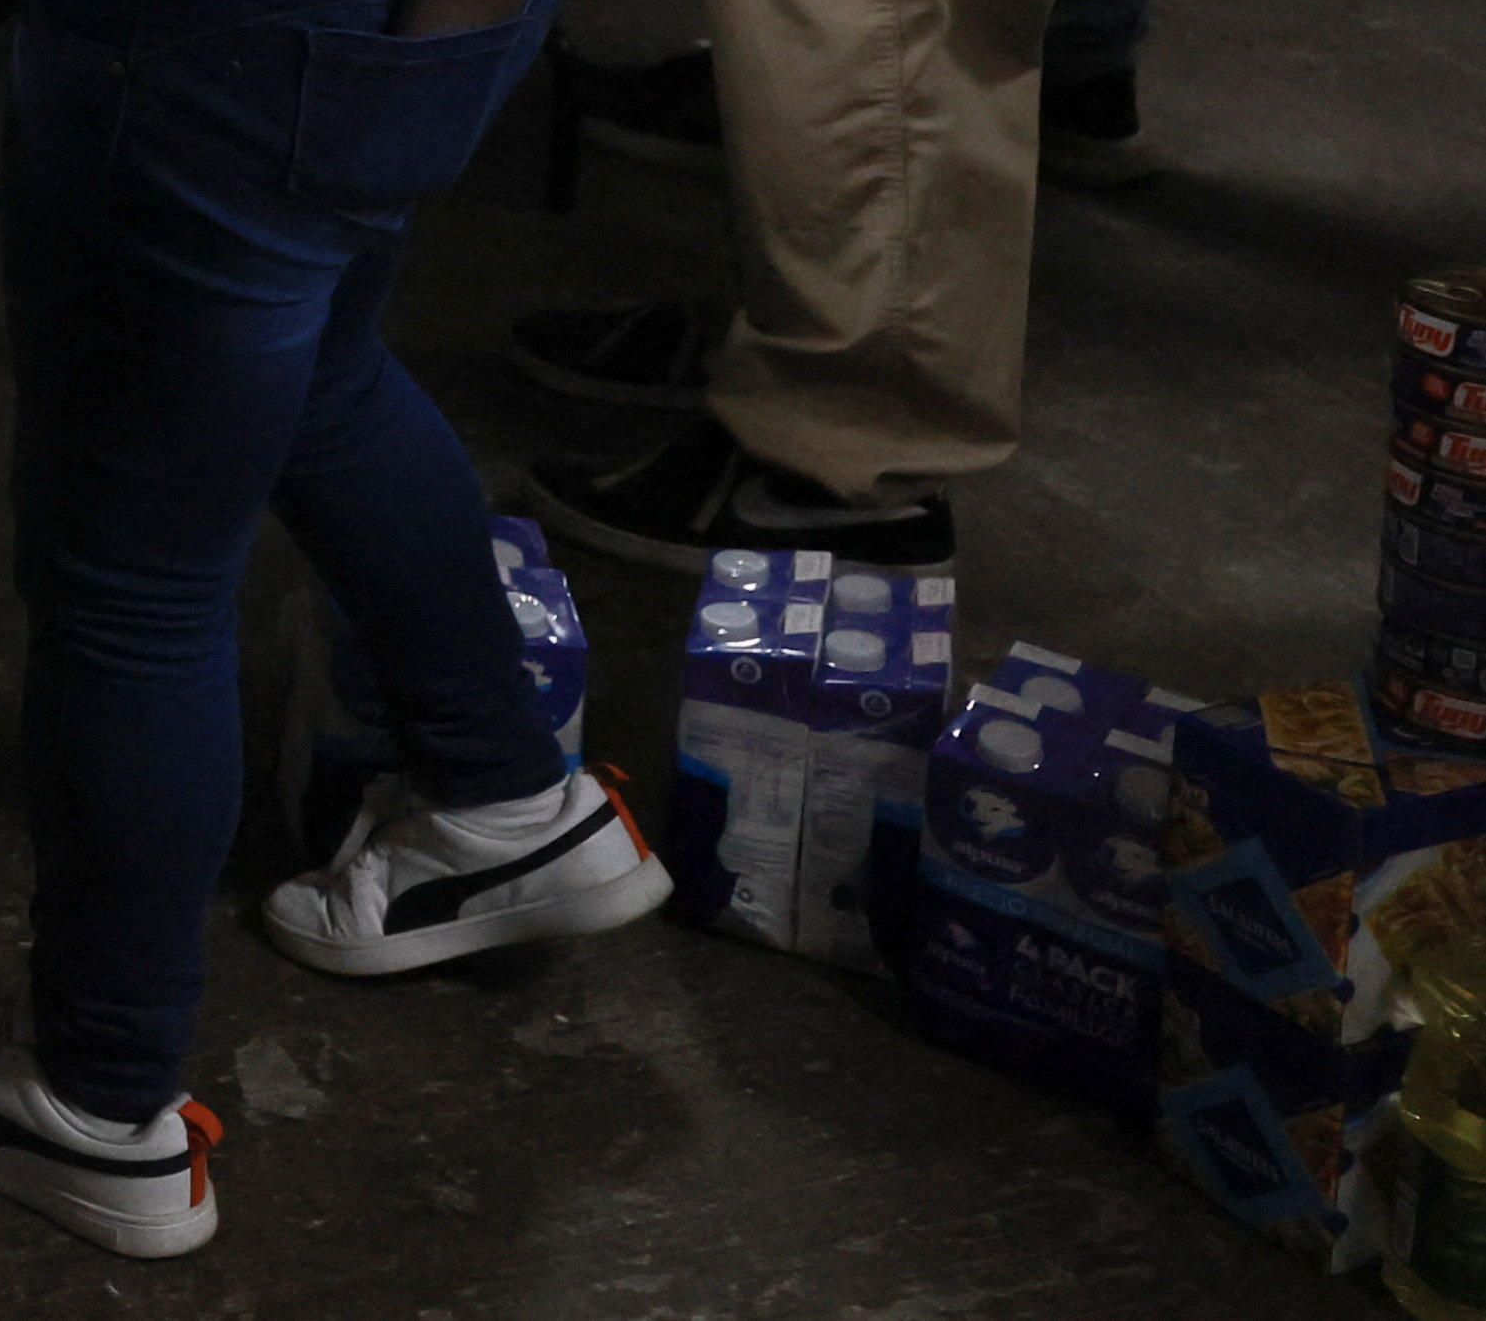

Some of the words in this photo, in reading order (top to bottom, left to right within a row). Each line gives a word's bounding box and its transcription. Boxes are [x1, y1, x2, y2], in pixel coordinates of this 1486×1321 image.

[1402, 304, 1454, 352] Tuny
[1015, 934, 1040, 959] 4
[1047, 945, 1139, 1002] PACK
